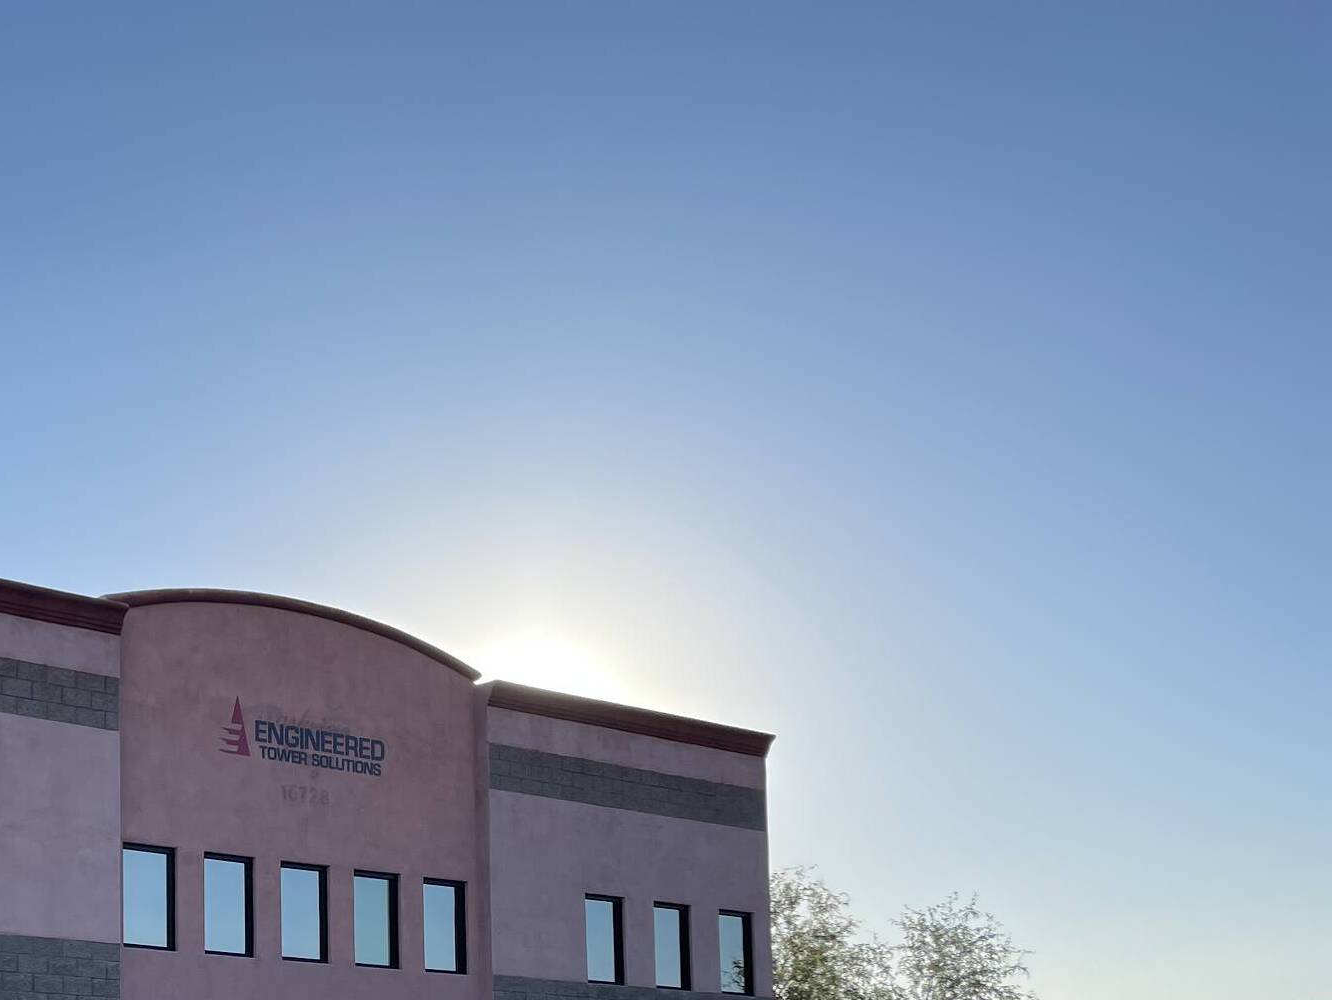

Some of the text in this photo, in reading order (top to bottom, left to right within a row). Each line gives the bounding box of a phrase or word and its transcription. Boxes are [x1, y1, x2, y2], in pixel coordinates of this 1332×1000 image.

[254, 719, 385, 761] ENGINEERED
[259, 745, 382, 777] TOWER SOLUTIONS
